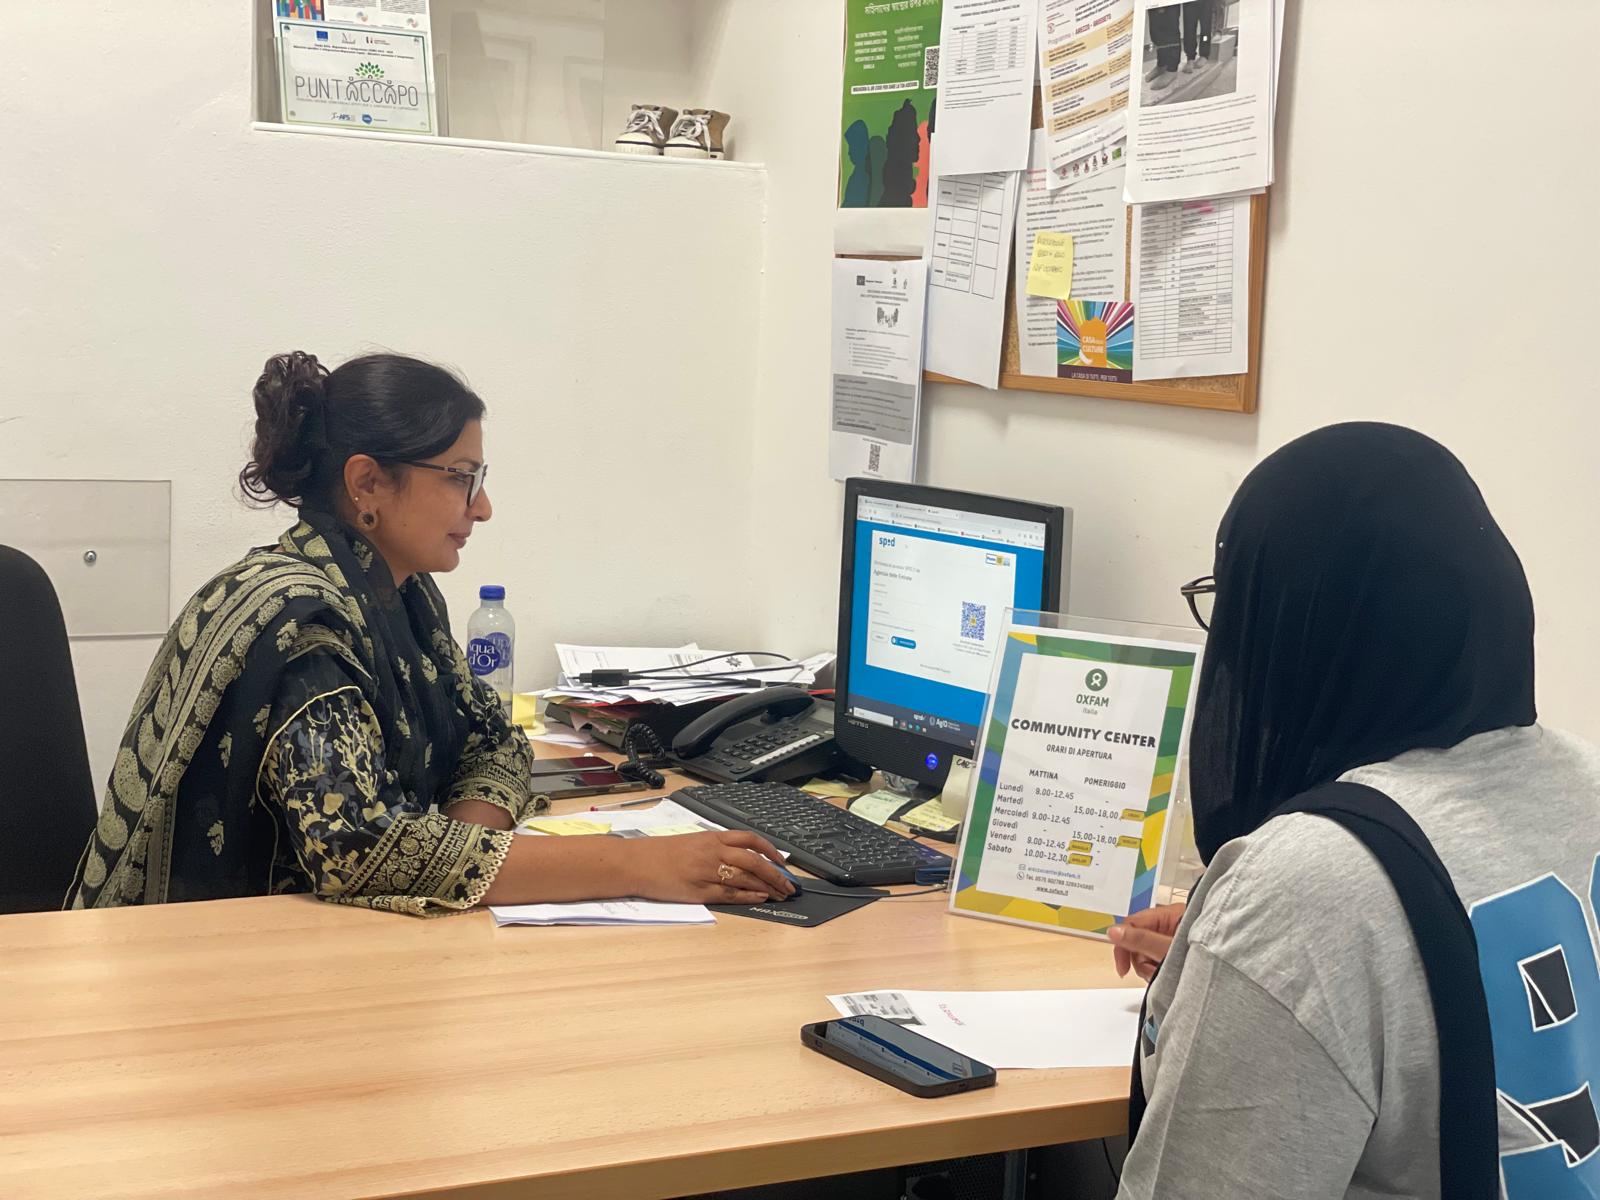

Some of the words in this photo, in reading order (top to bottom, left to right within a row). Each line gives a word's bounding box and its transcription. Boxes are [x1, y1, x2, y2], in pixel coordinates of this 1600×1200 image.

[1076, 694, 1110, 707] OXFAM
[1011, 719, 1101, 740] COMMUNITY
[1104, 731, 1156, 748] CENTER
[1046, 744, 1067, 755] ORARI
[1068, 747, 1075, 755] DI
[1076, 749, 1112, 760] APERTURA
[1028, 769, 1059, 780] MATTINA
[999, 782, 1023, 792] Lunedì
[1084, 777, 1126, 790] POMERIGGIO
[997, 794, 1023, 805] Martedì
[994, 807, 1028, 818] Mercoledì
[992, 818, 1018, 829] Giovedì
[990, 831, 1017, 841] Venerdì
[987, 843, 1012, 854] Sabato
